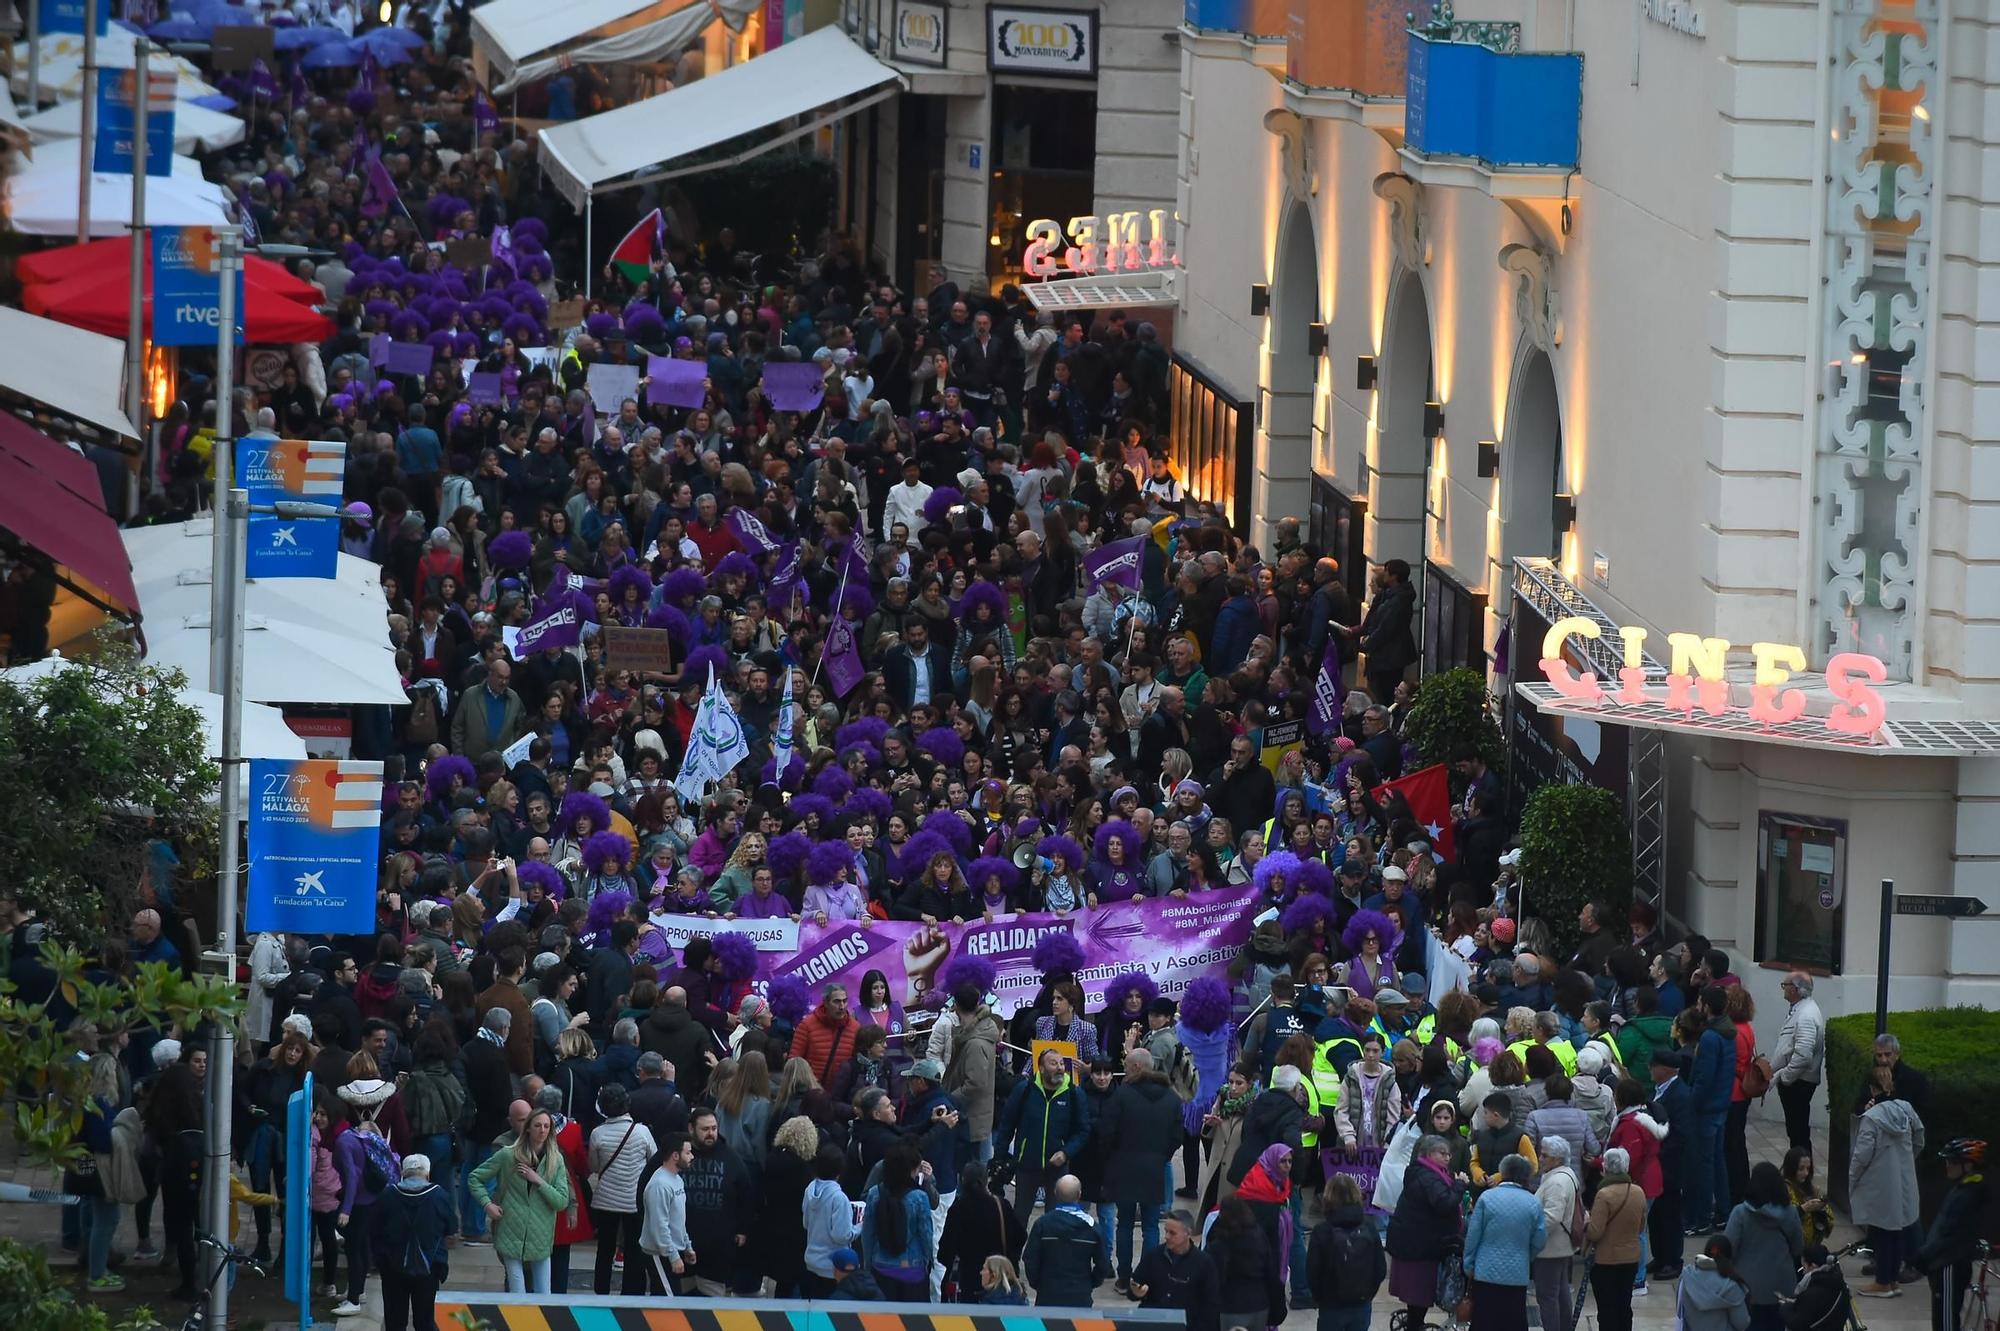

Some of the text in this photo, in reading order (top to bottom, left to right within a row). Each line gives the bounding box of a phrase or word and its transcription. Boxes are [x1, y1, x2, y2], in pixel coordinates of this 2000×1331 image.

[907, 15, 933, 38] 100
[1013, 22, 1069, 48] 100
[176, 303, 220, 326] rtve
[247, 449, 269, 468] 27
[1538, 615, 1888, 734] CINES
[263, 773, 290, 795] 27
[274, 896, 312, 906] Fundación
[1161, 896, 1252, 919] #8MAbolicionista
[1199, 926, 1222, 940] #8M
[1075, 962, 1146, 982] eminista
[1151, 961, 1161, 974] y
[1166, 944, 1243, 970] Asociativ
